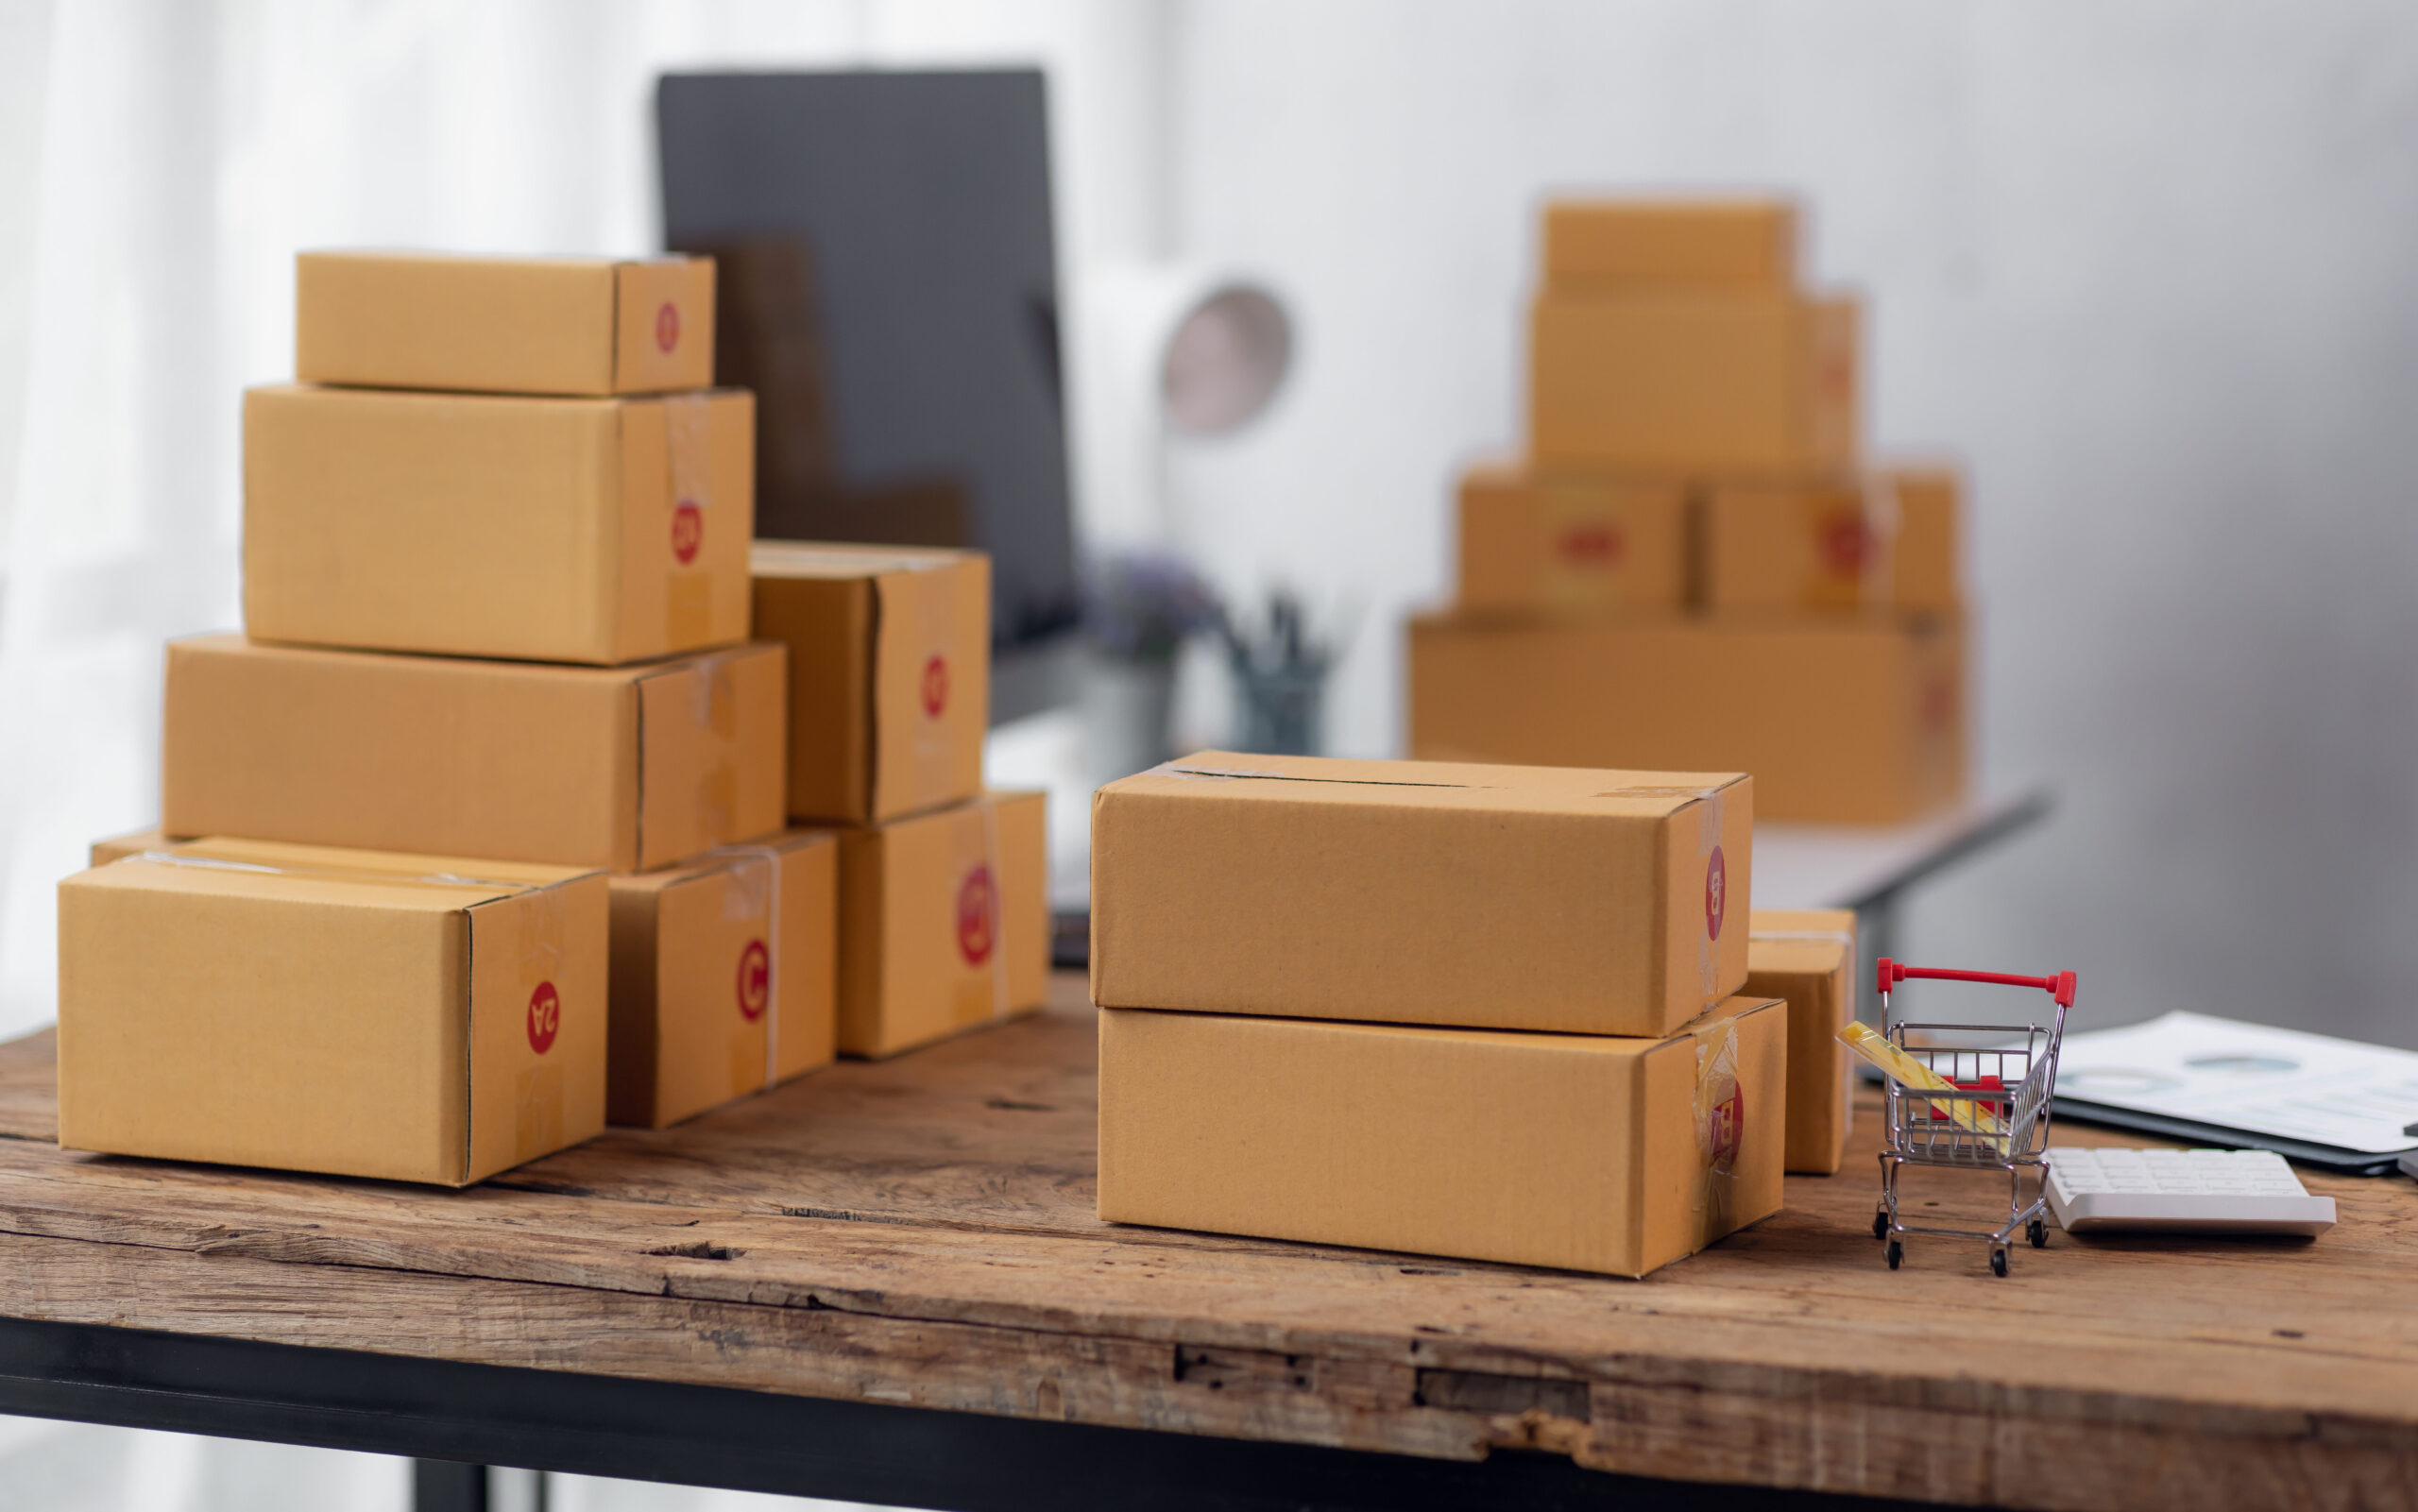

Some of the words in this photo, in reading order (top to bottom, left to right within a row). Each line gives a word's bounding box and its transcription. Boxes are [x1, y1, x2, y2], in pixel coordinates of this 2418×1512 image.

[741, 948, 766, 1011] C
[531, 998, 556, 1037] 2A
[1720, 1100, 1734, 1146] B
